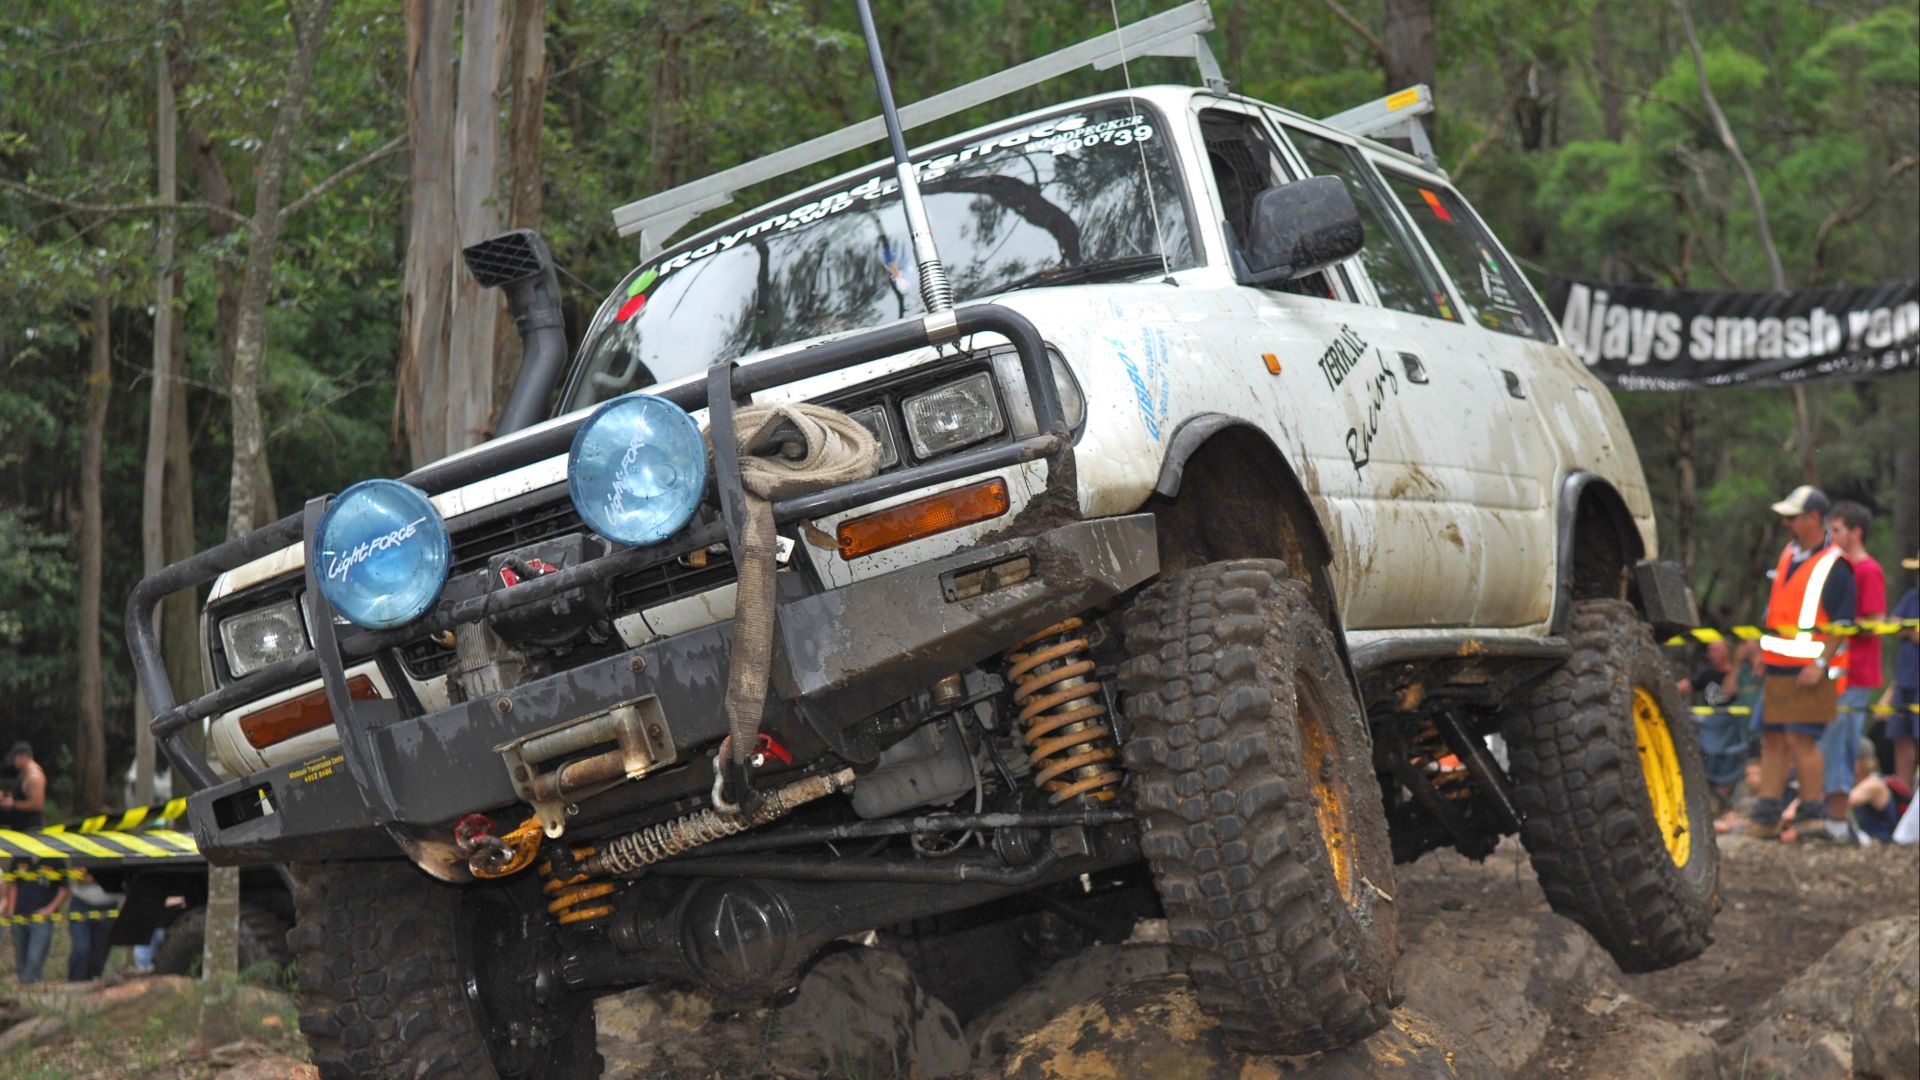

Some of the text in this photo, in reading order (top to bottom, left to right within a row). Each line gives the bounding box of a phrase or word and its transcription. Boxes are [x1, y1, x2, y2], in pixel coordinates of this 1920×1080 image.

[659, 117, 1088, 277] Raymond Terrace
[780, 168, 947, 231] 4WD CLB
[1562, 283, 1681, 366] Ajays
[1689, 307, 1841, 360] smash
[328, 516, 427, 582] LightFORCE
